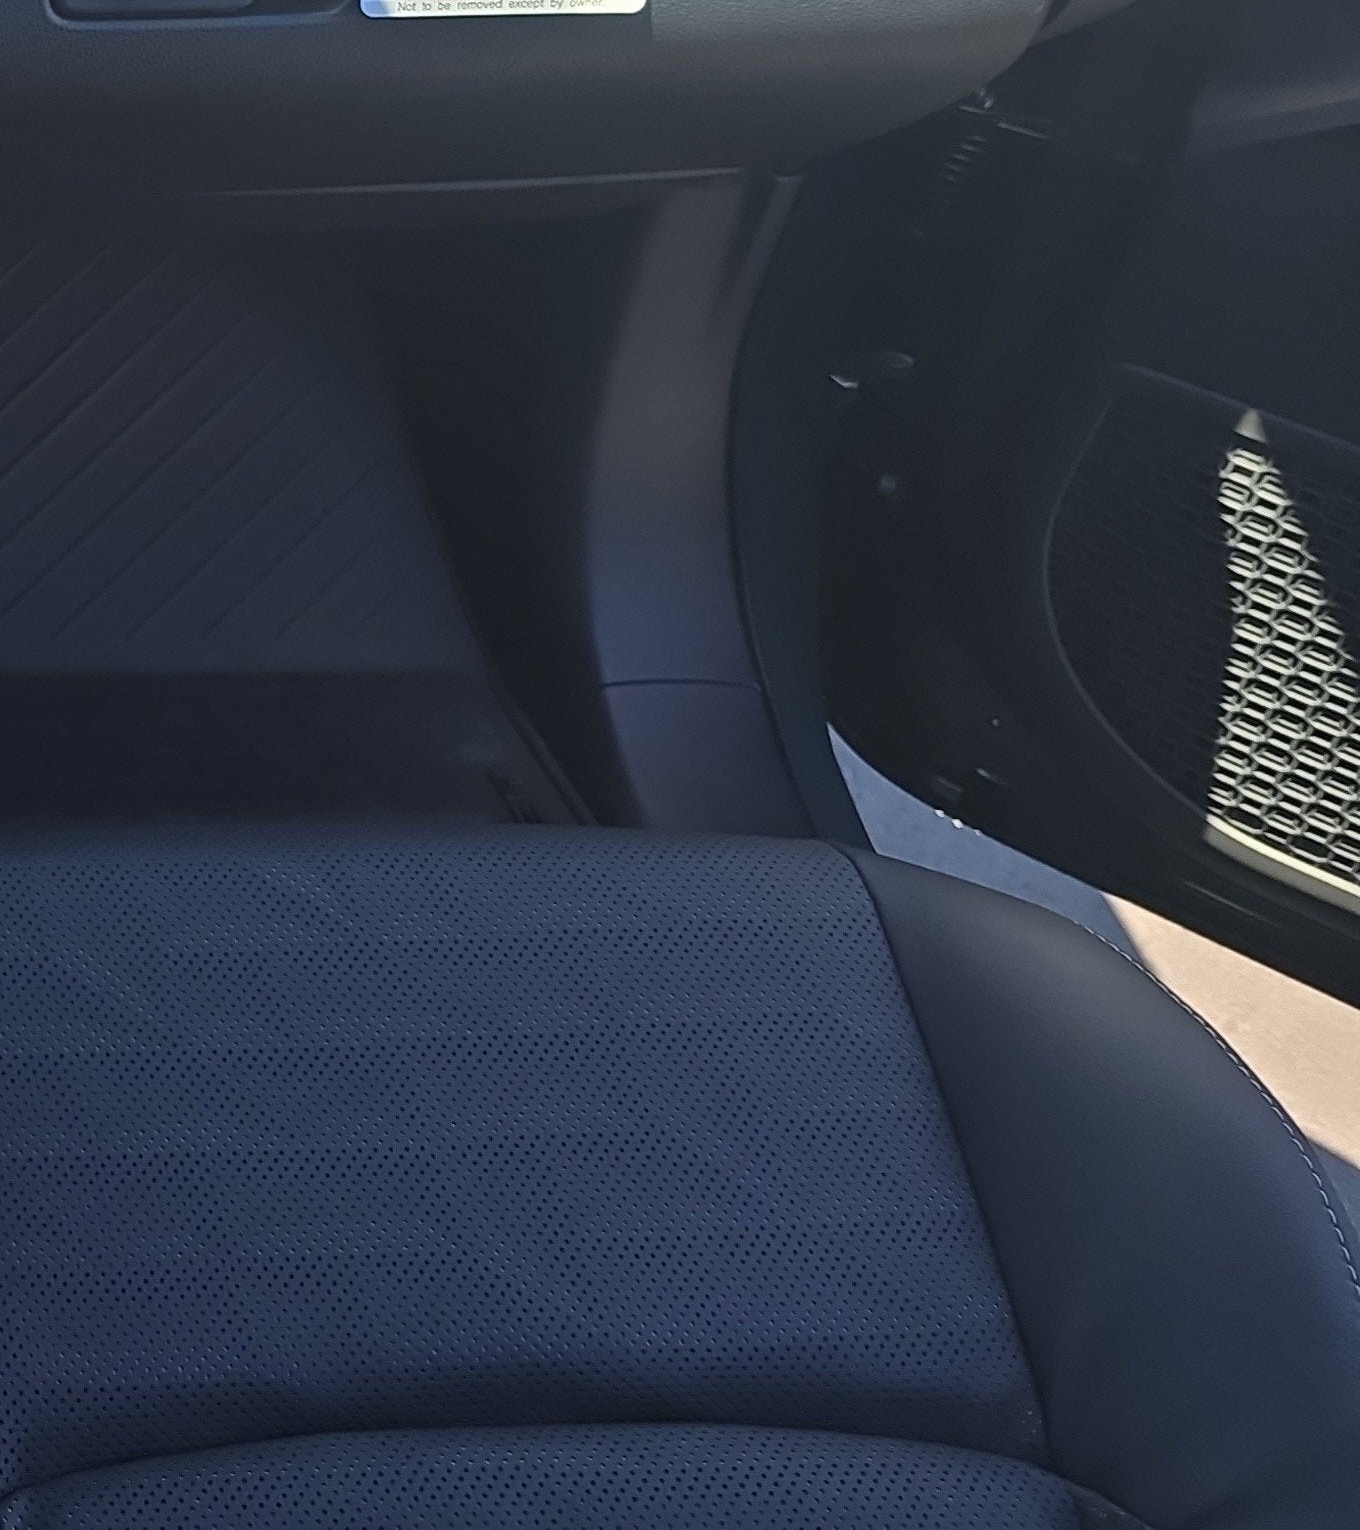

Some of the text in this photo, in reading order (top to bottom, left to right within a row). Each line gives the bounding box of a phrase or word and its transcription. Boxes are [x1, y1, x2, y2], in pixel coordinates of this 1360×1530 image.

[398, 1, 416, 11] Not
[422, 1, 432, 11] to
[438, 1, 450, 11] be
[457, 0, 503, 10] removed
